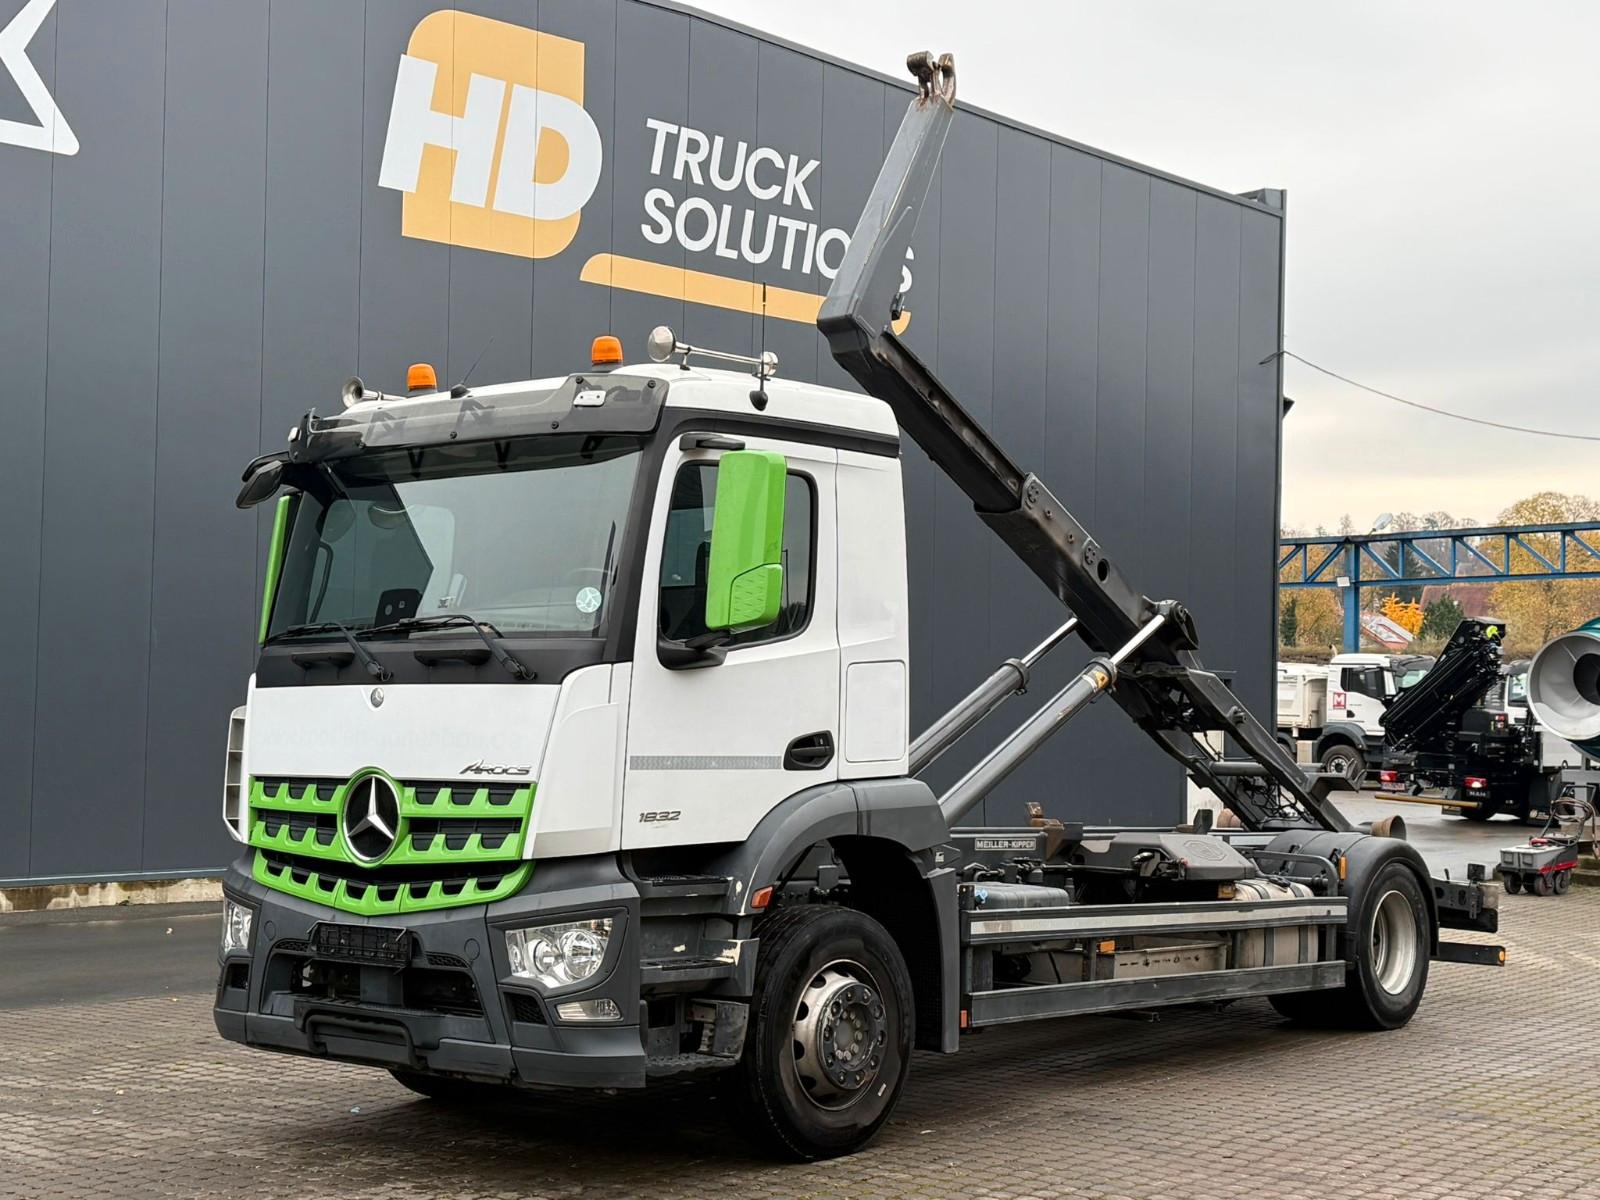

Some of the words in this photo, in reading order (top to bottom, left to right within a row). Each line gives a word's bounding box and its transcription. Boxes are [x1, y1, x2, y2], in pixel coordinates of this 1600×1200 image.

[378, 54, 603, 221] HD
[646, 118, 821, 212] TRUCK
[640, 188, 915, 294] SOLUTIO
[638, 810, 682, 823] 1832
